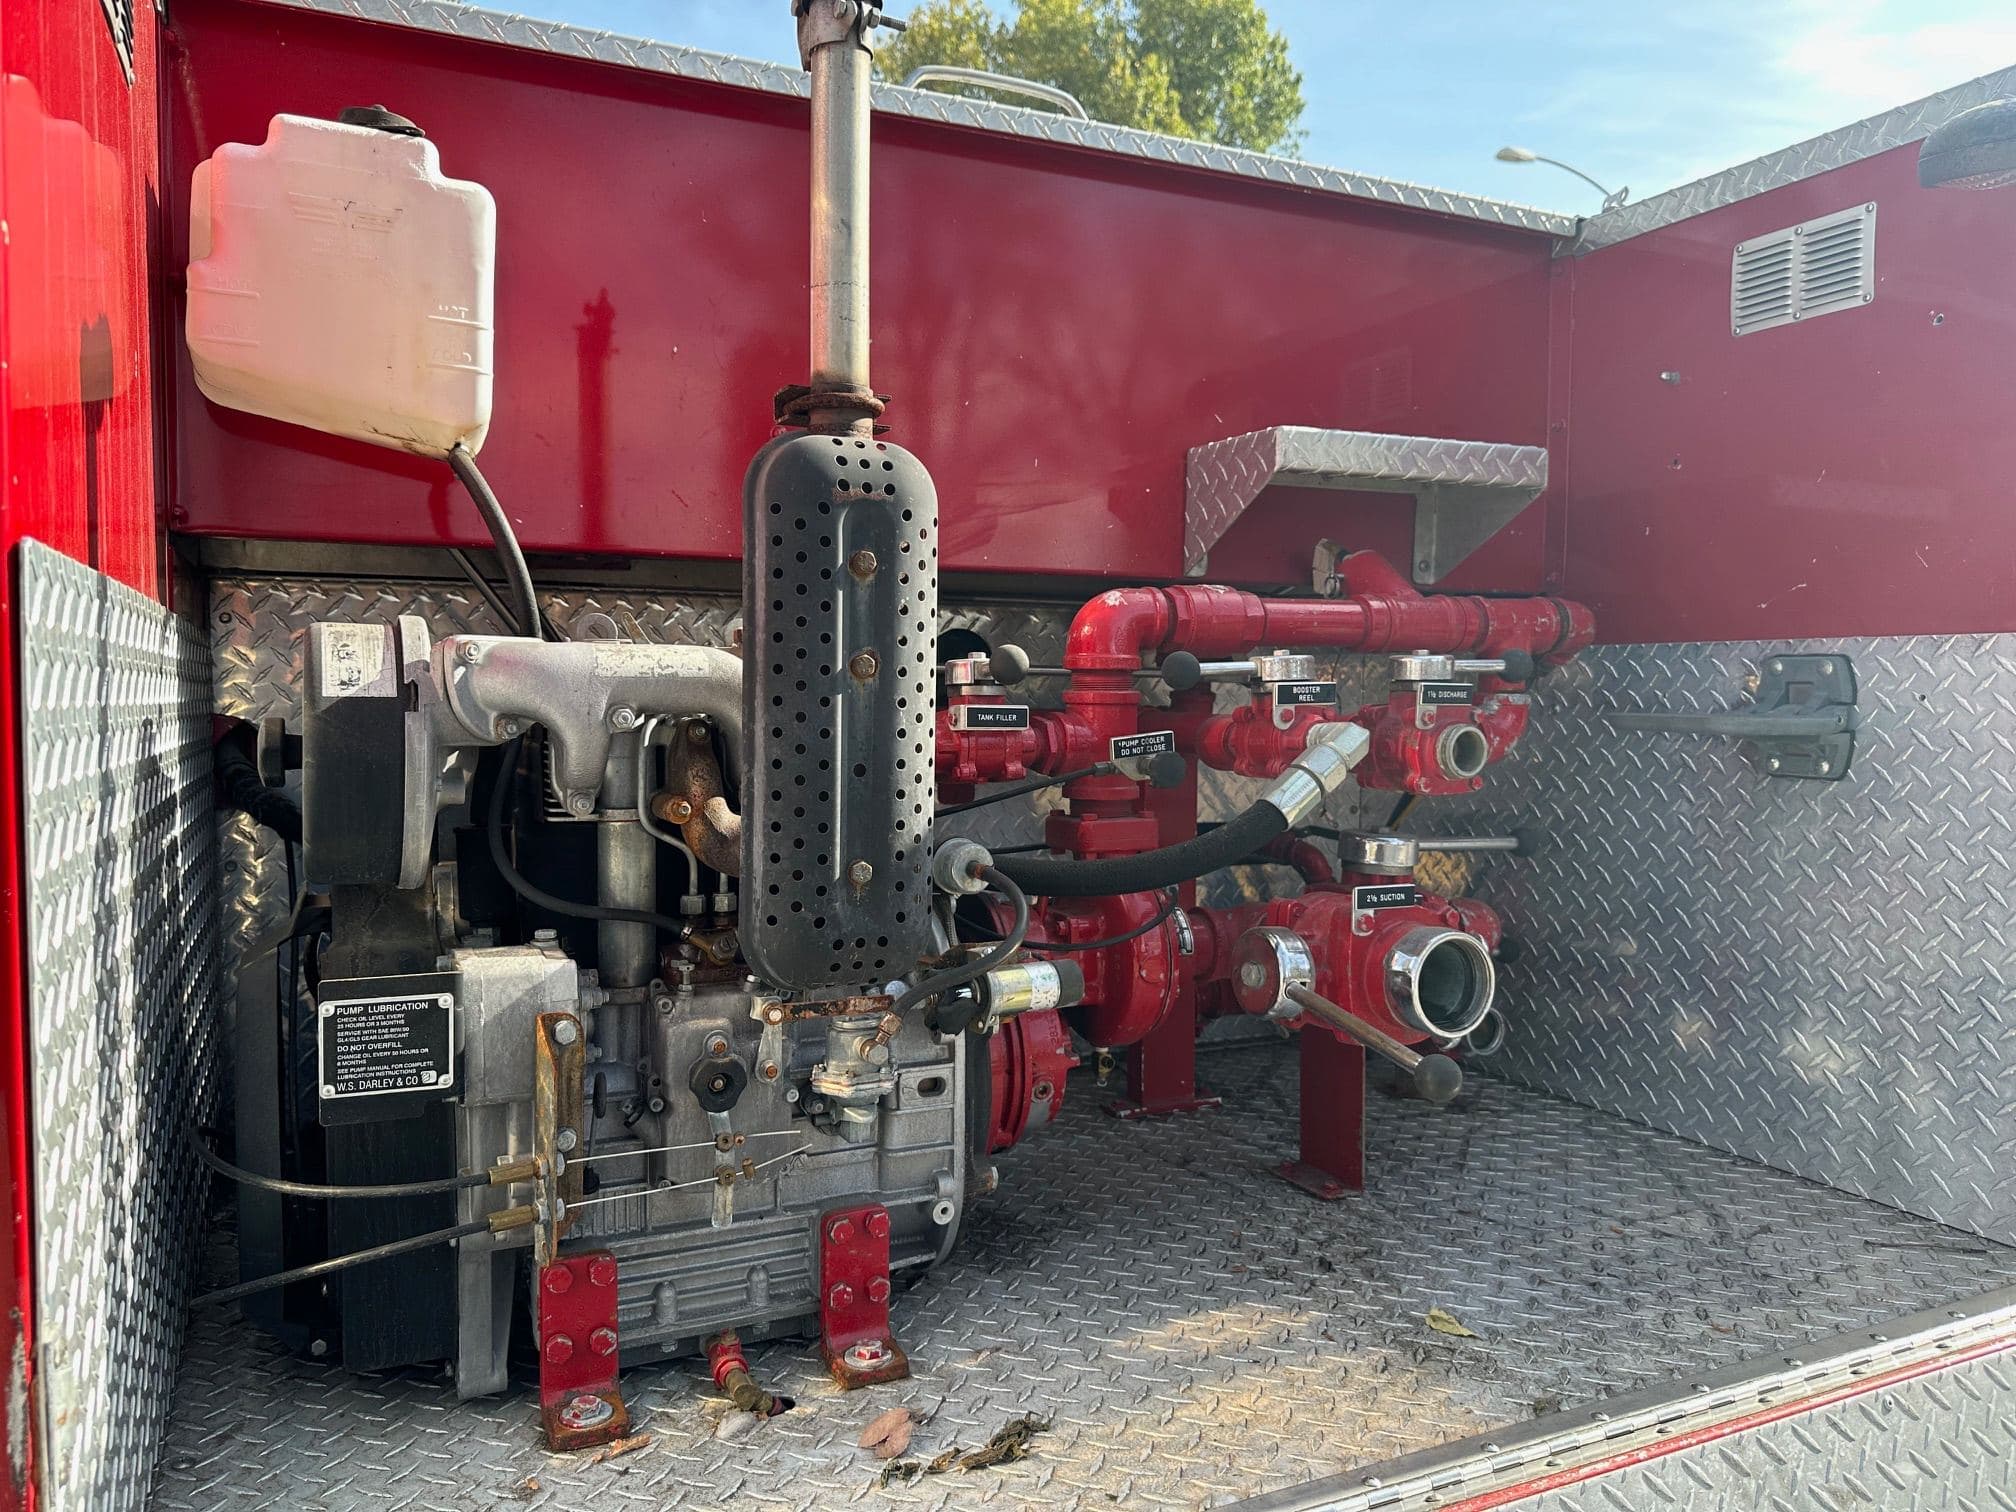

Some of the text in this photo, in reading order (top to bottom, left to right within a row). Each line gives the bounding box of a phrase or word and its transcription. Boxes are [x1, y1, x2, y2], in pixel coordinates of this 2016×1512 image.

[1293, 686, 1321, 694] BOOSTER
[1438, 690, 1468, 699] DISCHARGE
[1299, 694, 1315, 702] REEL
[978, 713, 1017, 721] TANK FILLER
[1141, 736, 1165, 746] COOLER
[1121, 743, 1166, 756] DO NOT CLOSE
[1380, 893, 1406, 902] SUCTION
[337, 1002, 428, 1015] PUMP LUBRICATION
[368, 1042, 402, 1050] OVERFILL
[337, 1069, 416, 1080] LUBRICATION INSTRUCTIONS
[337, 1076, 418, 1092] W.S. DARLEY & CO
